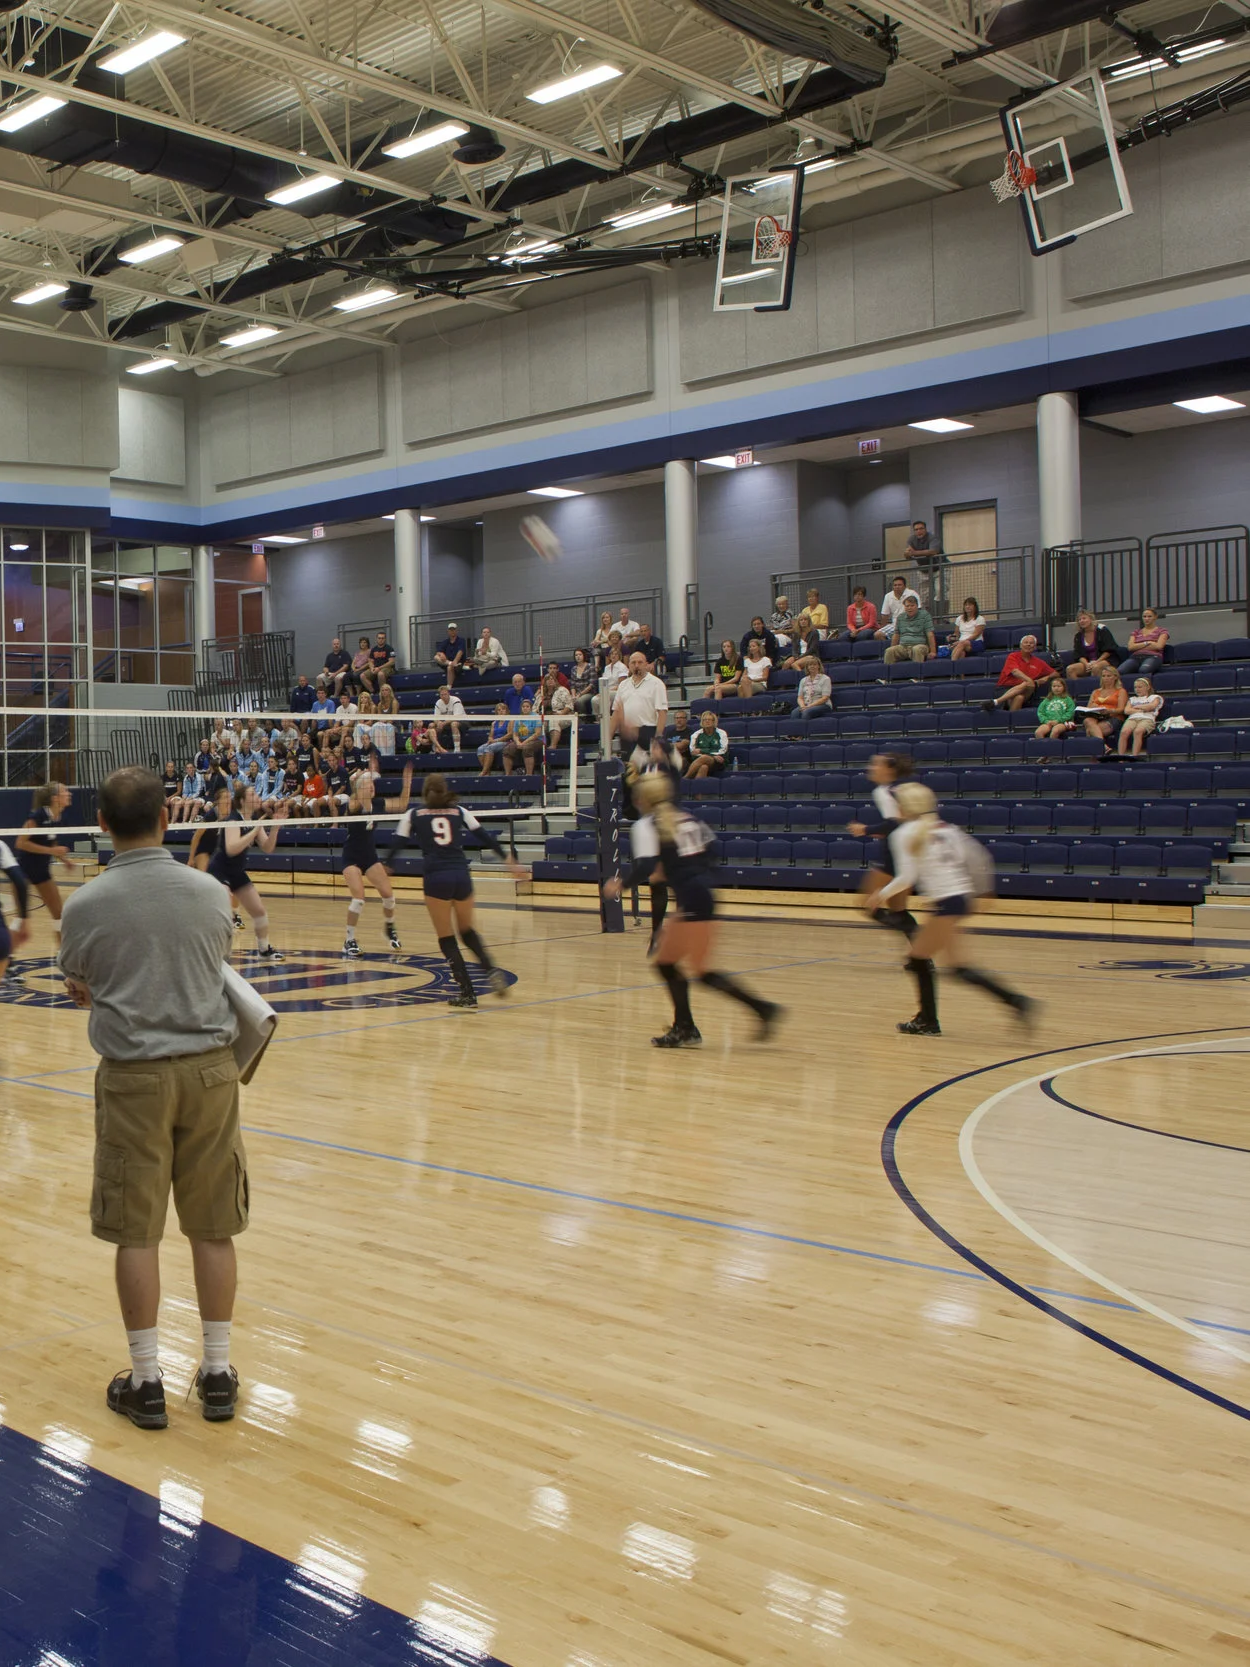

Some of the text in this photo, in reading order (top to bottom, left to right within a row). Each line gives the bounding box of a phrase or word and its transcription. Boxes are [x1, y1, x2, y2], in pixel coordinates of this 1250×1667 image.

[861, 441, 877, 455] EXIT
[736, 453, 751, 465] EXIT
[431, 816, 453, 846] 9
